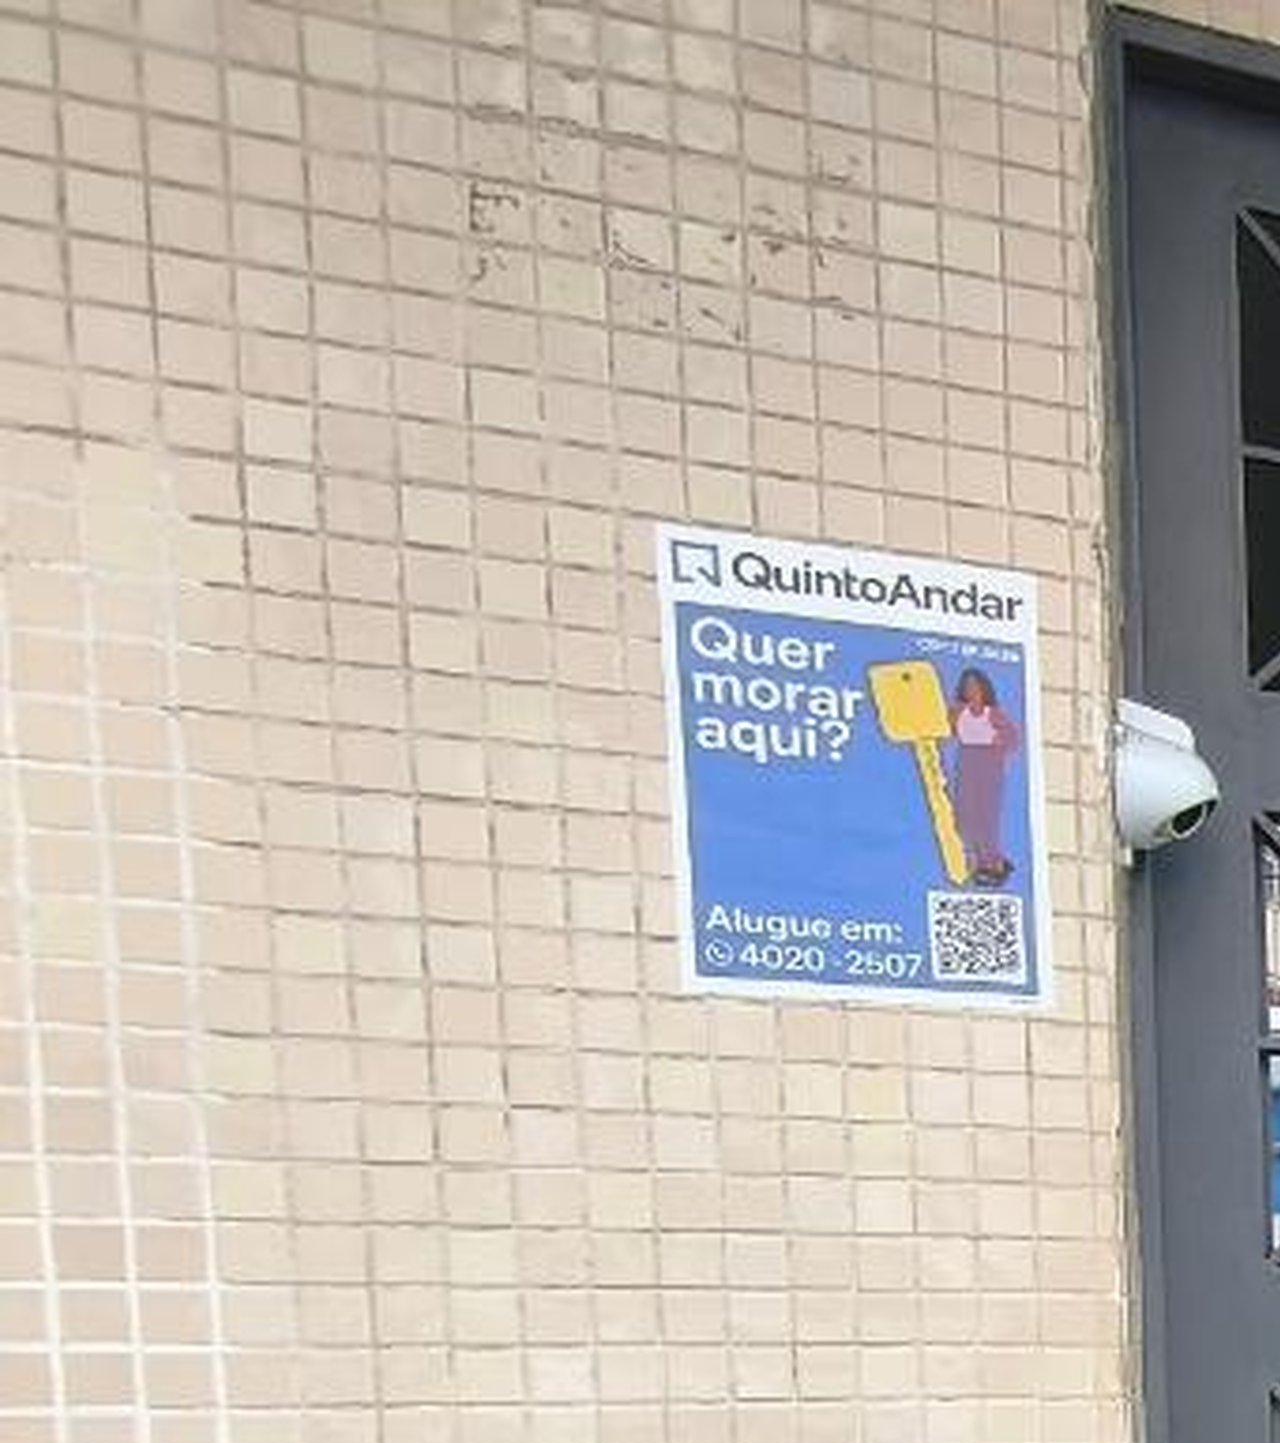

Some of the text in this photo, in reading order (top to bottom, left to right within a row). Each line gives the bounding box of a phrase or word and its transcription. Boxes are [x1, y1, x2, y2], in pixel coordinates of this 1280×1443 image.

[732, 552, 1023, 621] QuintoAndar
[690, 616, 834, 670] Quer
[693, 671, 863, 720] morar
[696, 715, 850, 763] aqui?
[705, 905, 903, 943] Alugue em:
[739, 943, 825, 972] 4020
